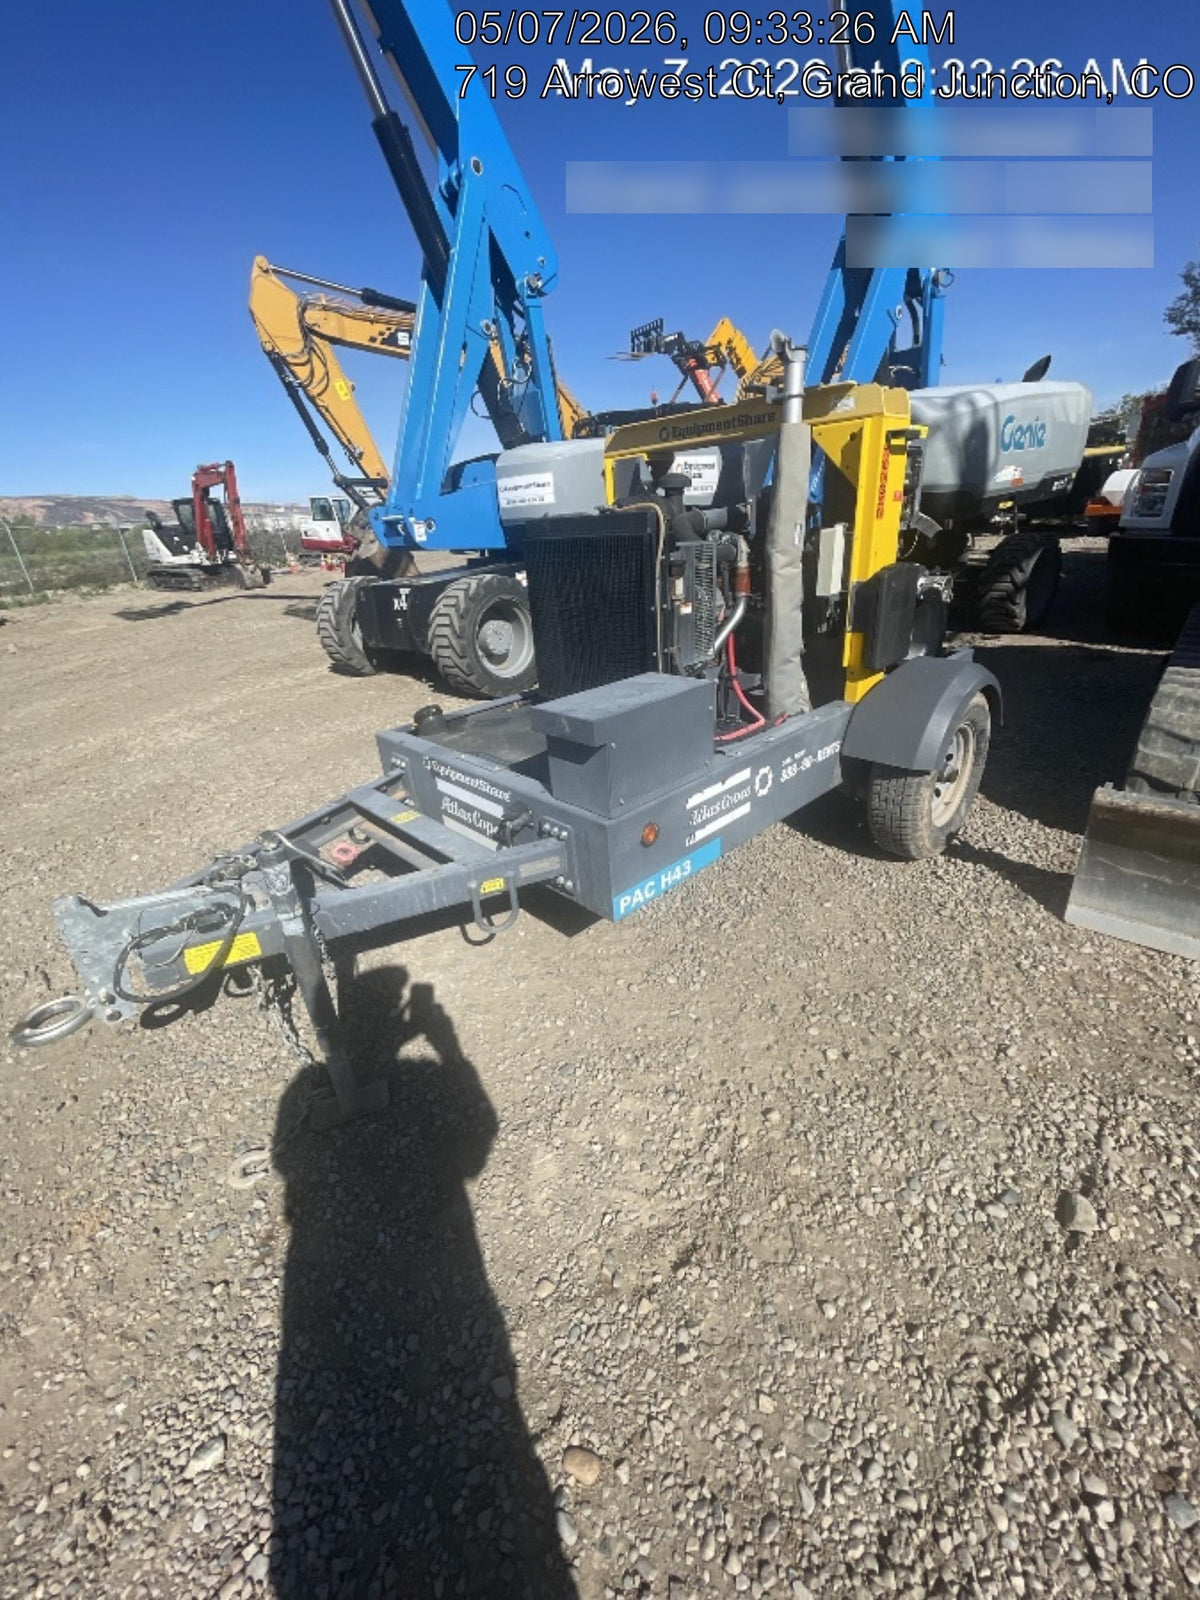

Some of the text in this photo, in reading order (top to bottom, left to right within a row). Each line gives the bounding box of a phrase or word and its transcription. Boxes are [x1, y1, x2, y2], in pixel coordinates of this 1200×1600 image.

[671, 411, 777, 439] EquipmentShare
[1000, 415, 1046, 452] Genie
[440, 795, 499, 836] Atlas Copc
[619, 859, 692, 914] PAC H43
